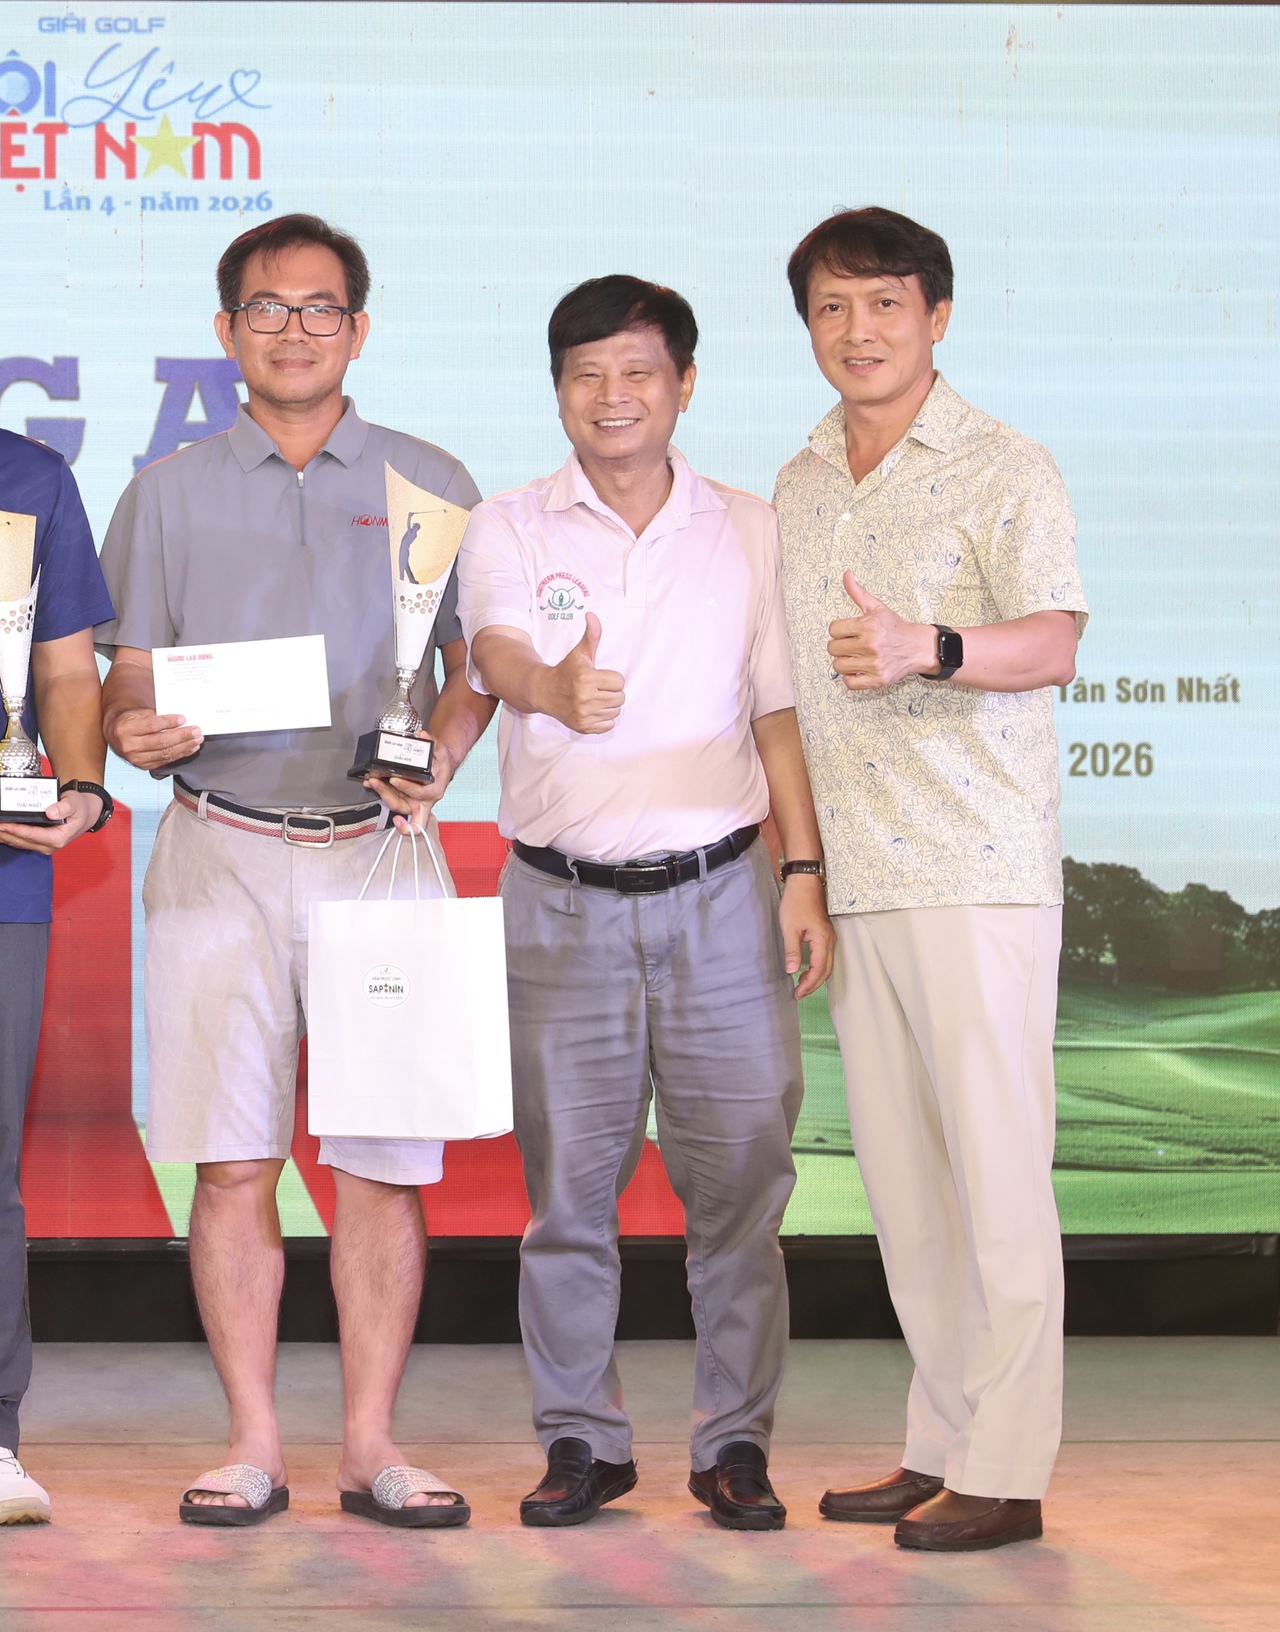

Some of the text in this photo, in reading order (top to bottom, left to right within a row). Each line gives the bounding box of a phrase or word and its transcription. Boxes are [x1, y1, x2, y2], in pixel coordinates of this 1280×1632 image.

[38, 12, 165, 34] GIẢI GOLF
[99, 196, 116, 216] 4
[141, 191, 200, 211] năm
[207, 191, 273, 212] 2026
[351, 514, 388, 526] HONM
[555, 572, 572, 580] PRESS
[1115, 676, 1166, 704] Sơn
[1176, 672, 1241, 704] Nhất
[1068, 742, 1154, 778] 2026
